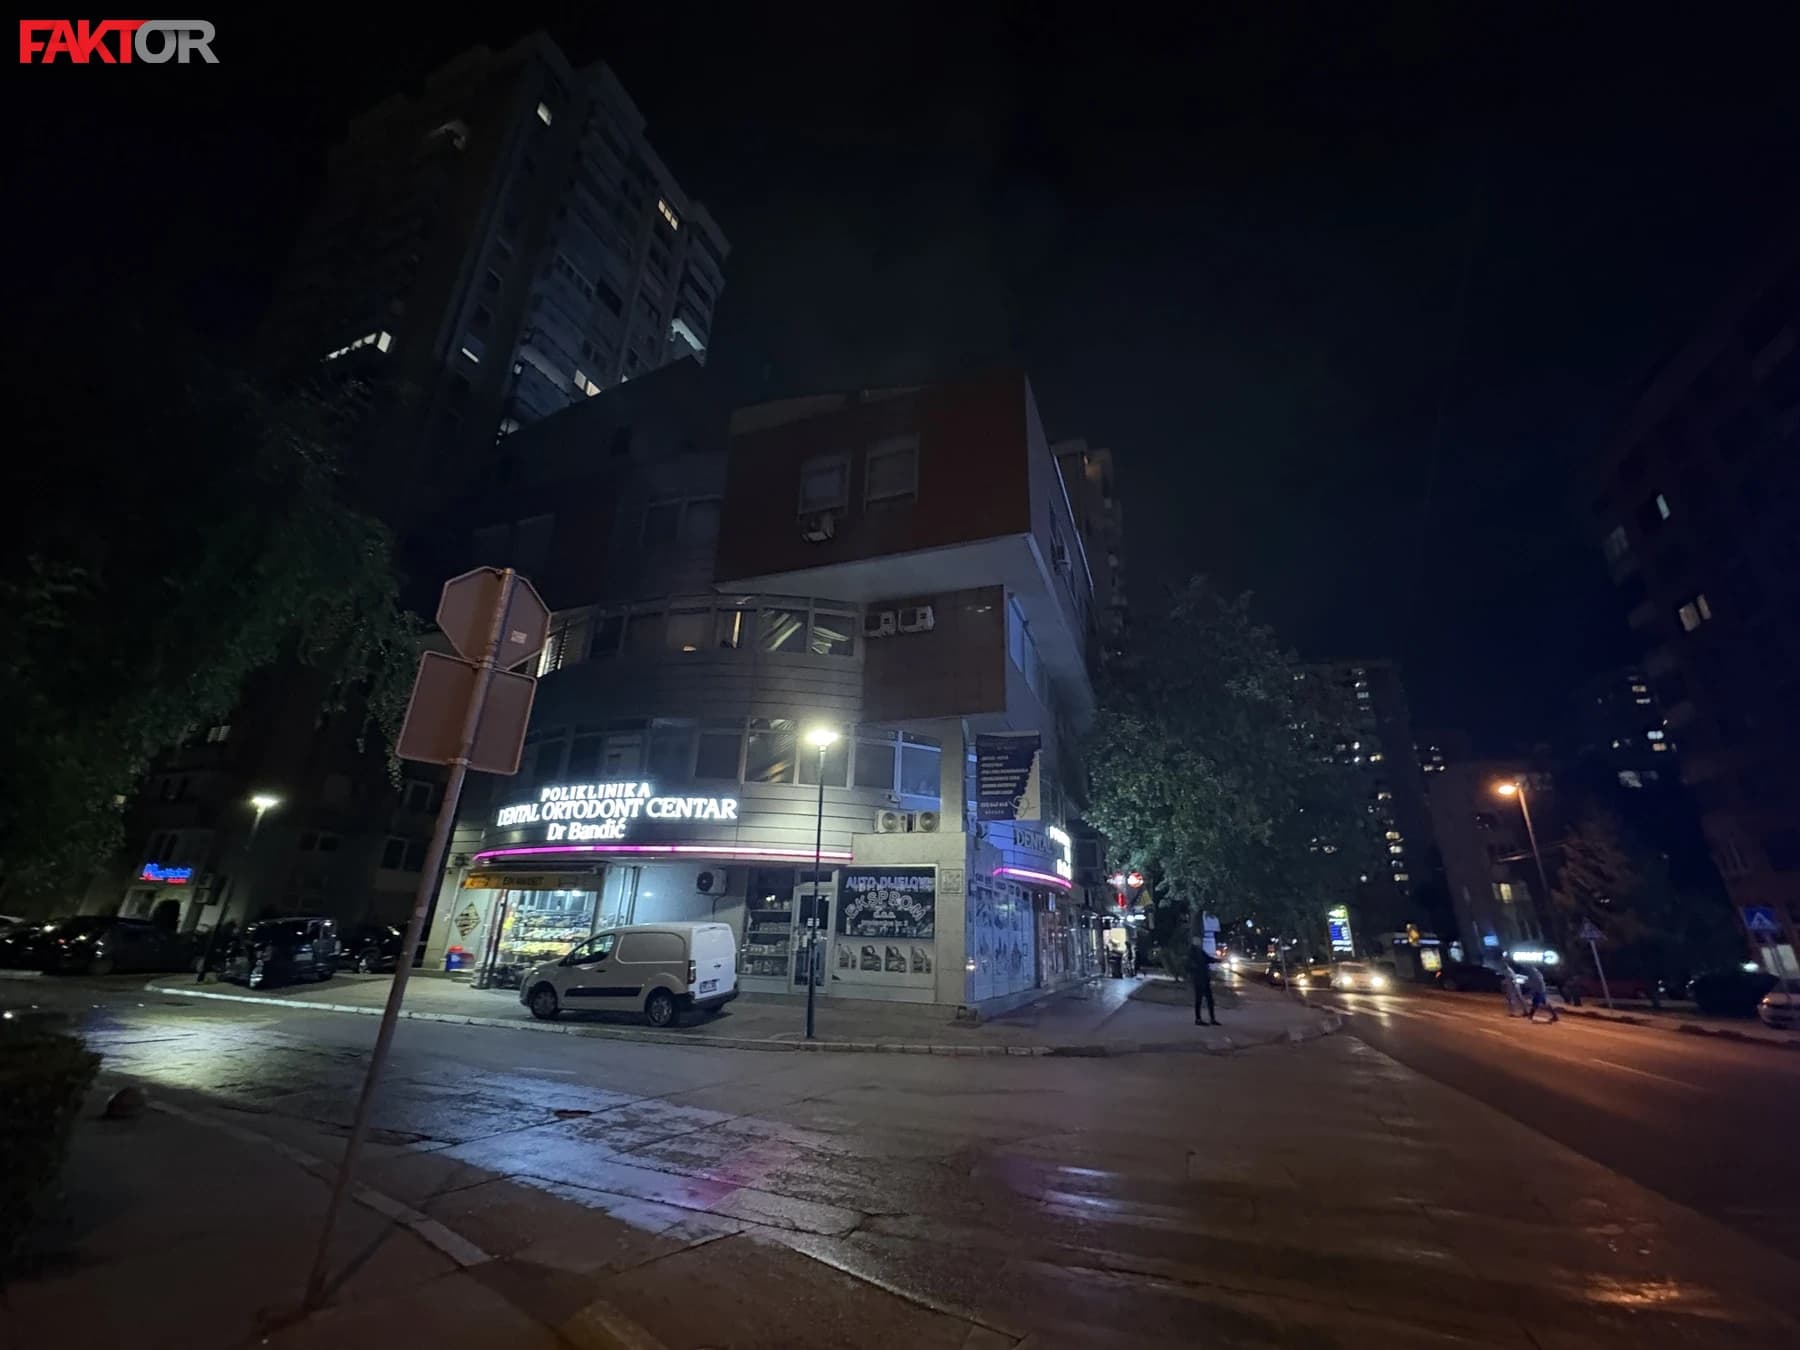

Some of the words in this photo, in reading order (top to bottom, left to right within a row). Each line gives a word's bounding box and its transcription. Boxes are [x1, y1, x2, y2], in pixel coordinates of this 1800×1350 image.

[541, 783, 651, 801] POLIKLINIKA
[497, 803, 539, 826] DENTAL
[542, 799, 644, 819] ORTODONT
[647, 798, 737, 819] CENTAR
[547, 823, 567, 840] Dr
[845, 876, 878, 891] AUTO
